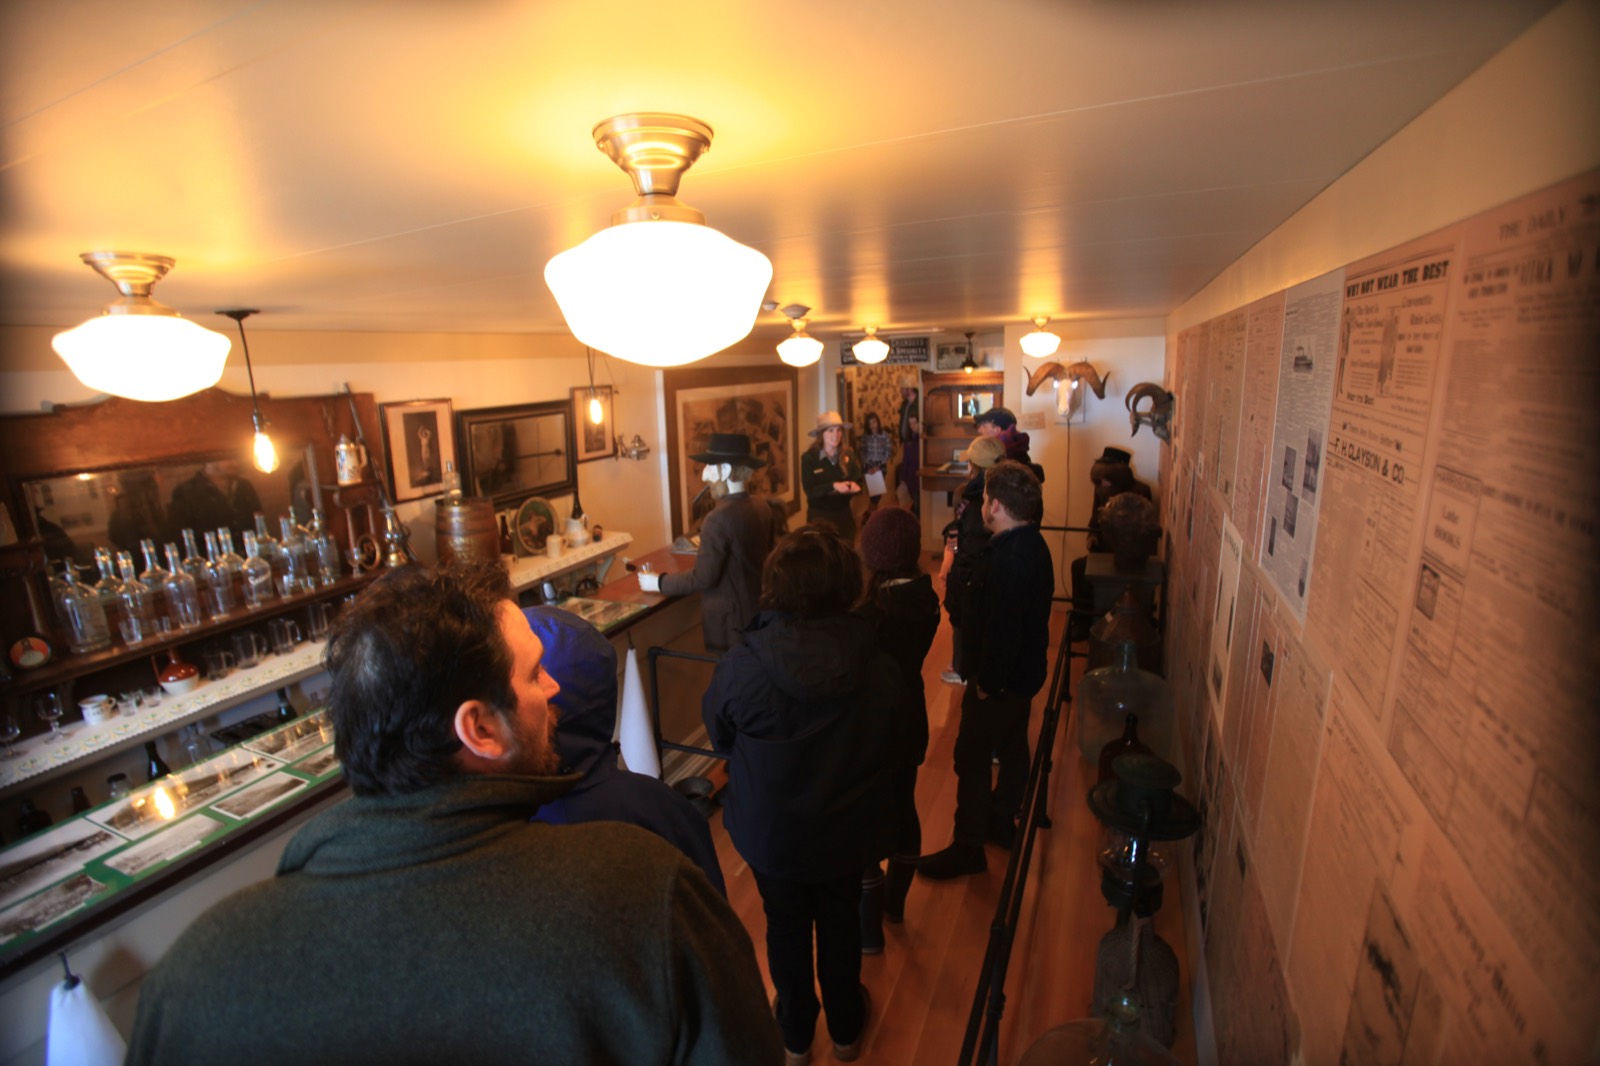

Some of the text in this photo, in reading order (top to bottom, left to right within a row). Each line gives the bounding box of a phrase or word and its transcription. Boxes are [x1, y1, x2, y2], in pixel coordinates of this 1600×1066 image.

[1346, 260, 1449, 297] WHY NOT WEAR THE BEST
[1348, 442, 1381, 473] CLAYSON
[1382, 458, 1389, 477] &
